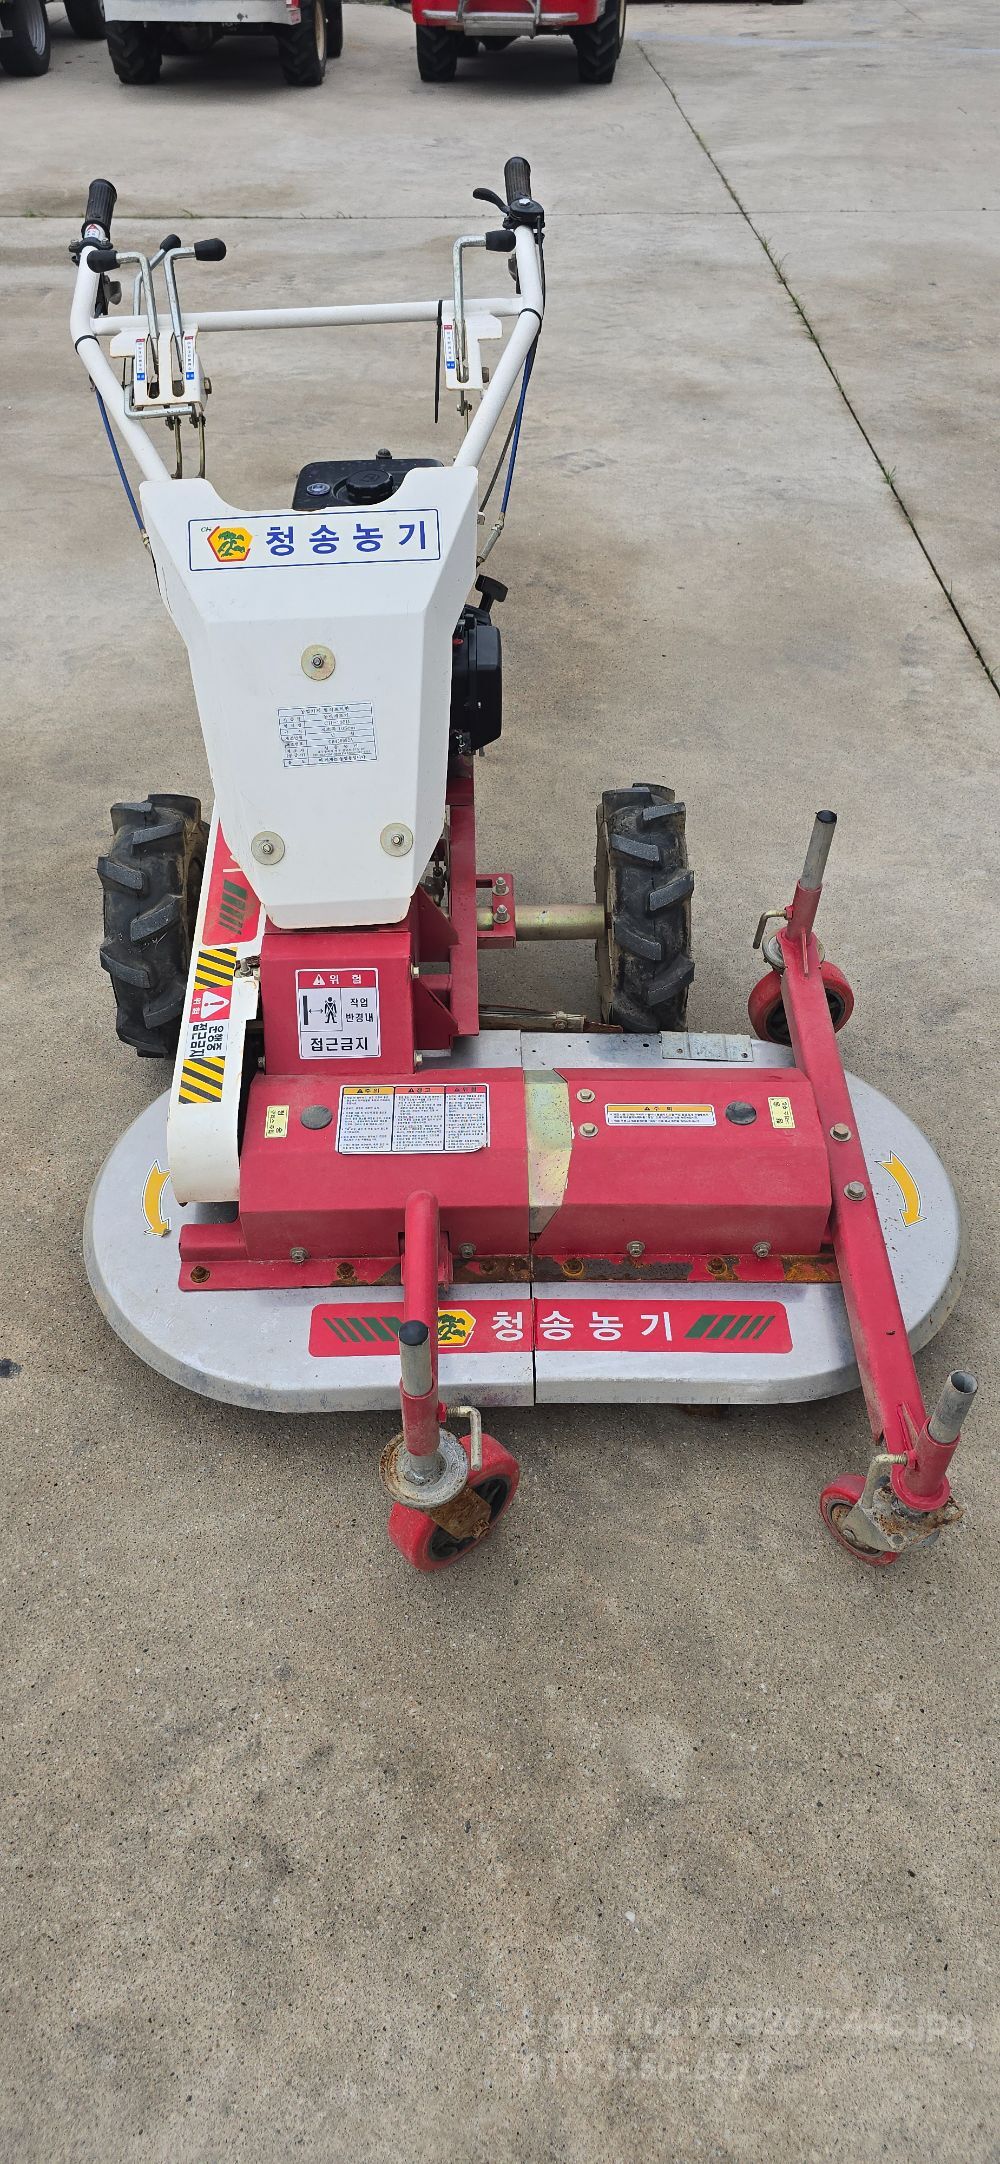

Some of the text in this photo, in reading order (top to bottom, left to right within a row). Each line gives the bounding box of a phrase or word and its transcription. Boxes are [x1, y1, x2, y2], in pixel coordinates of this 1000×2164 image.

[350, 997, 368, 1008] 작업
[345, 1012, 374, 1023] 반경내
[189, 1022, 208, 1058] 접근금지
[206, 1025, 224, 1051] 운행중
[310, 1036, 368, 1052] 접근금지
